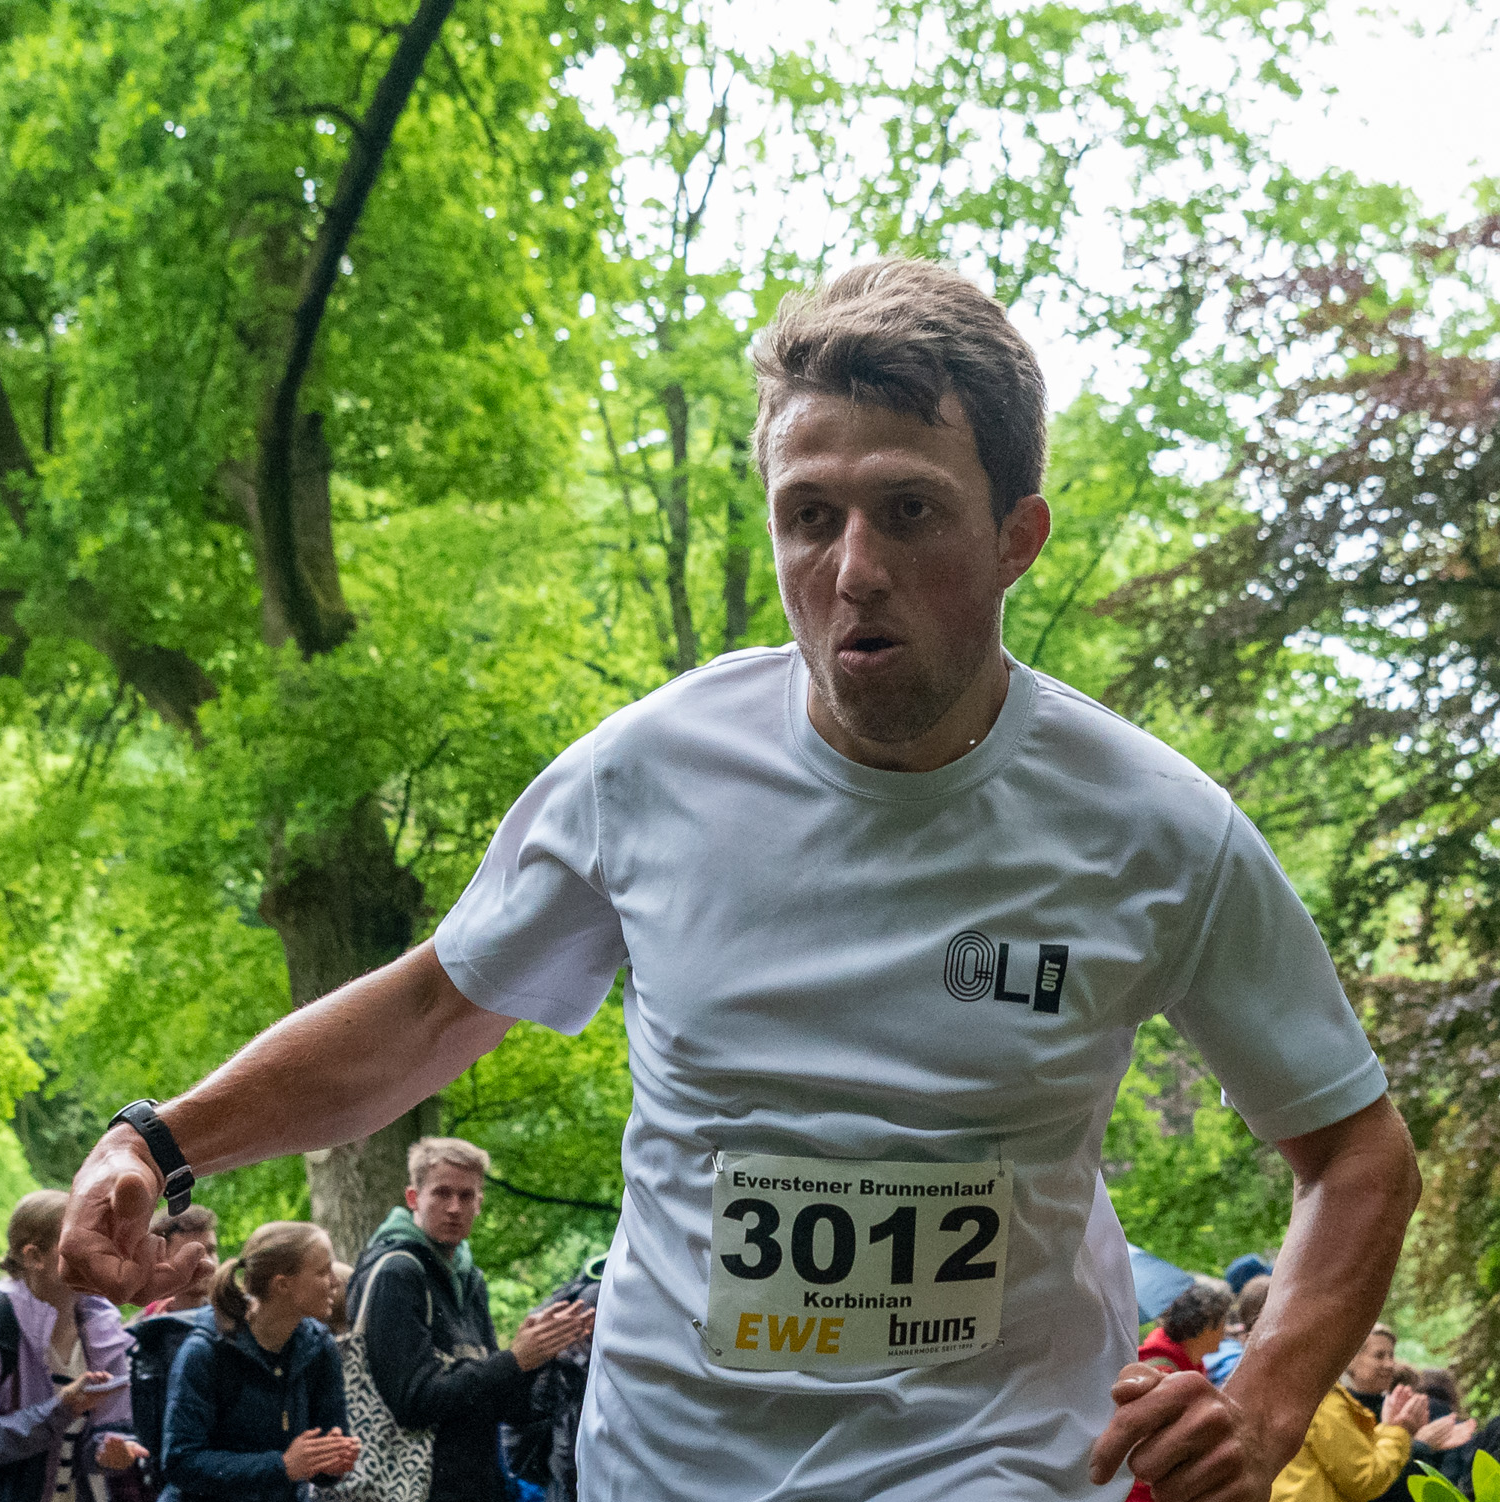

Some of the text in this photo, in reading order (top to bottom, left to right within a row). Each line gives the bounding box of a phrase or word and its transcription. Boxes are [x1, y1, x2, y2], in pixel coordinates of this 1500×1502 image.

[1041, 960, 1061, 992] OUT
[732, 1171, 996, 1197] Everstener Brunnenlauf
[720, 1198, 1001, 1285] 3012
[803, 1291, 912, 1309] Korbinian
[734, 1312, 846, 1354] EWE
[888, 1313, 977, 1347] bruns
